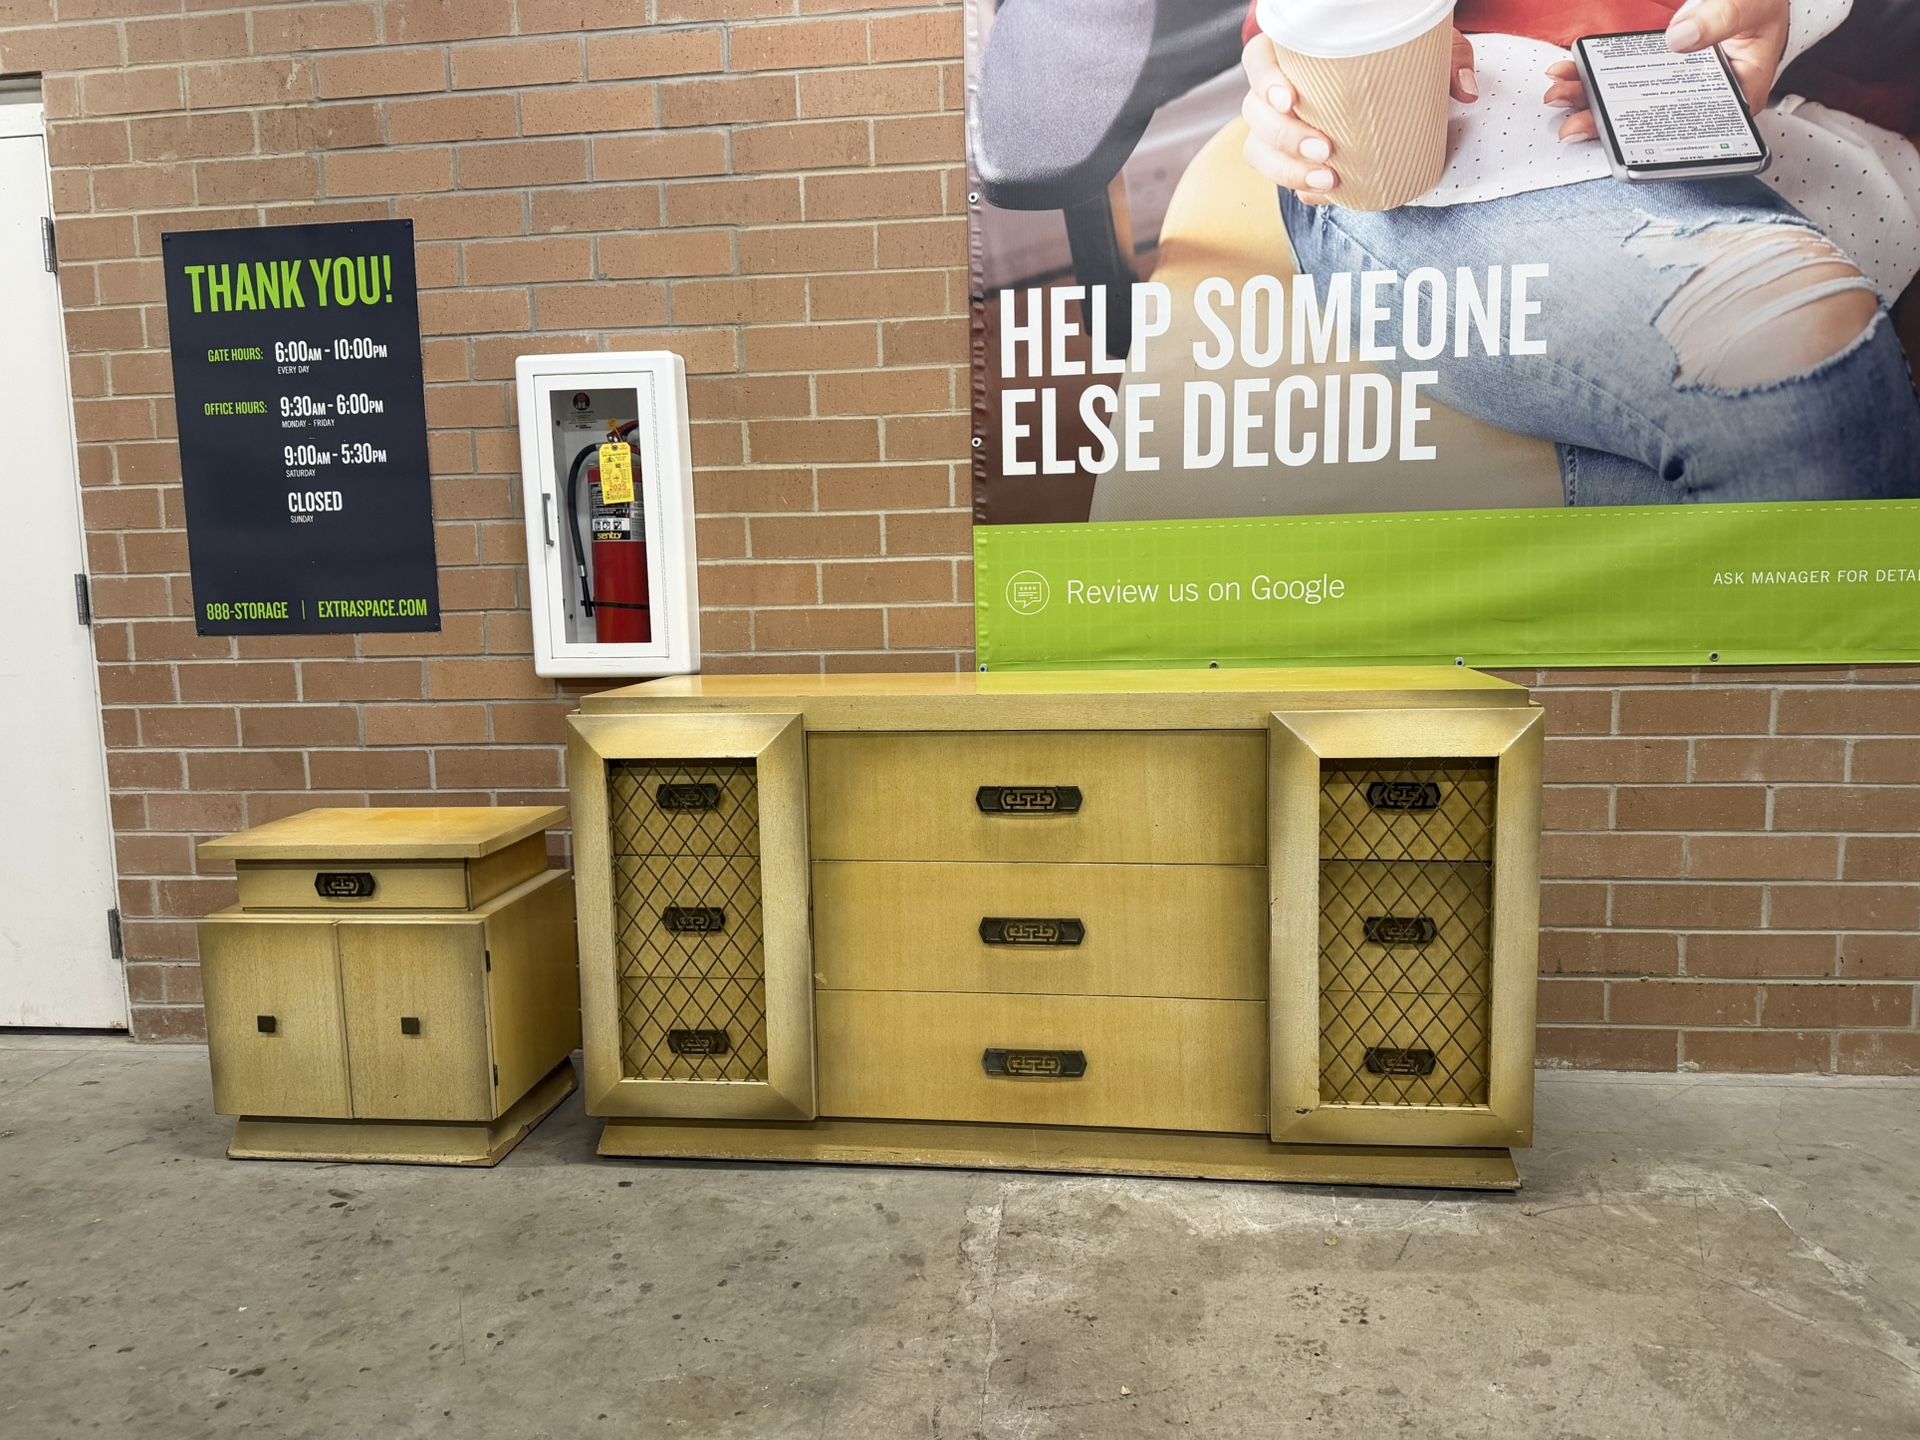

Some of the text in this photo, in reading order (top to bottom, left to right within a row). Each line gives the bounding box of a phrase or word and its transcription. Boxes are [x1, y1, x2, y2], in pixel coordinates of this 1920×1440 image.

[185, 255, 393, 313] THANK YOU!
[1000, 263, 1549, 379] HELP SOMEONE
[208, 349, 229, 363] GATE
[231, 347, 263, 361] HOURS:
[275, 341, 322, 363] 6:00AM
[334, 338, 387, 360] 10:00PM
[277, 365, 309, 374] EVERY DAY
[204, 401, 234, 416] OFFICE
[236, 400, 267, 415] HOURS:
[280, 395, 326, 417] 9:30AM
[336, 393, 383, 415] 6:00PM
[282, 420, 306, 428] MONDAY
[314, 419, 335, 427] FRIDAY
[1001, 371, 1439, 475] ELSE DECIDE
[284, 445, 331, 466] 9:00AM
[341, 443, 386, 464] 5:30PM
[286, 469, 316, 478] SATURDAY
[288, 491, 342, 512] CLOSED
[290, 515, 314, 523] SUNDAY
[1713, 572, 1744, 585] ASK
[1752, 570, 1830, 584] MANAGER
[1838, 570, 1868, 583] FOR
[1067, 574, 1345, 606] Review us on Google
[206, 599, 427, 620] 888-STORAGE EXTRASPACE.COM
